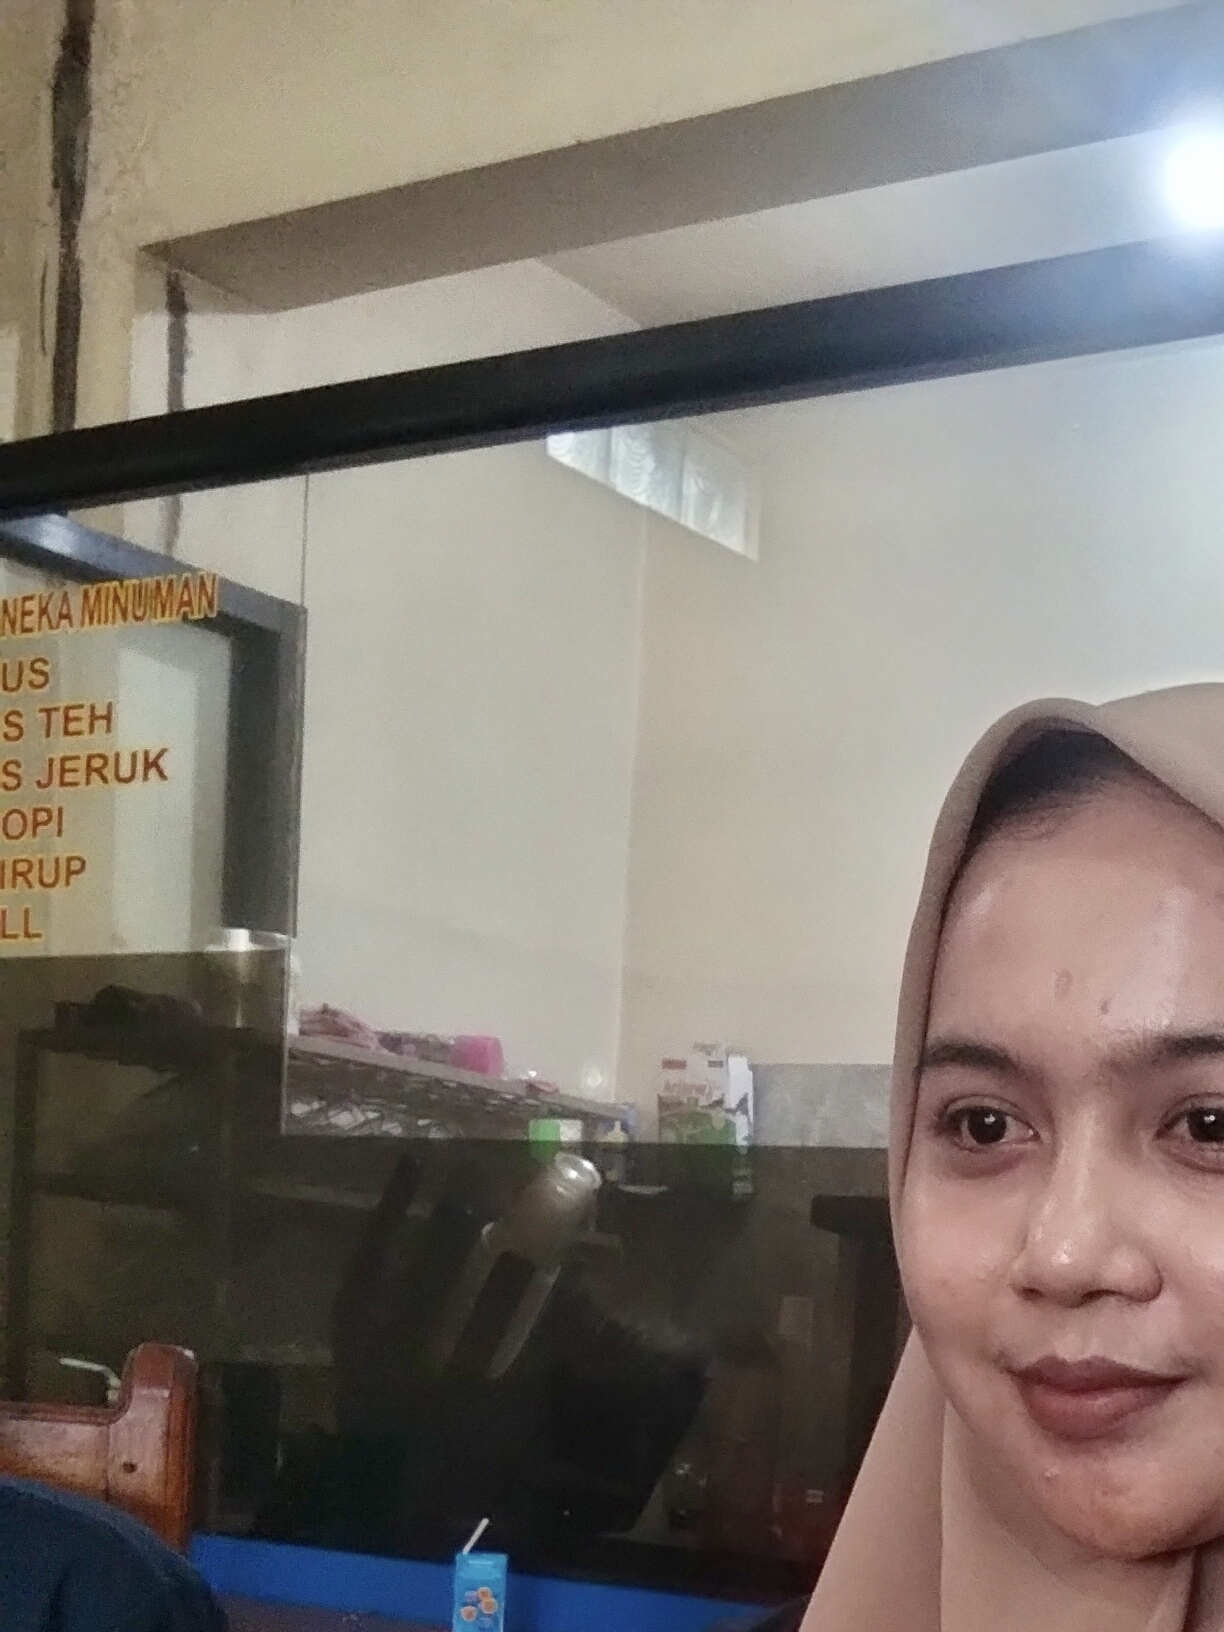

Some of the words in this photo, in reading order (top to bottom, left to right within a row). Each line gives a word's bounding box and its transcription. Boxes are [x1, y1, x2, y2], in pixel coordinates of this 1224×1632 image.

[80, 575, 218, 629] MINUMAN
[1, 656, 50, 693] US
[38, 700, 113, 738] TEH
[36, 747, 169, 789] JERUK
[2, 806, 63, 840] OPI
